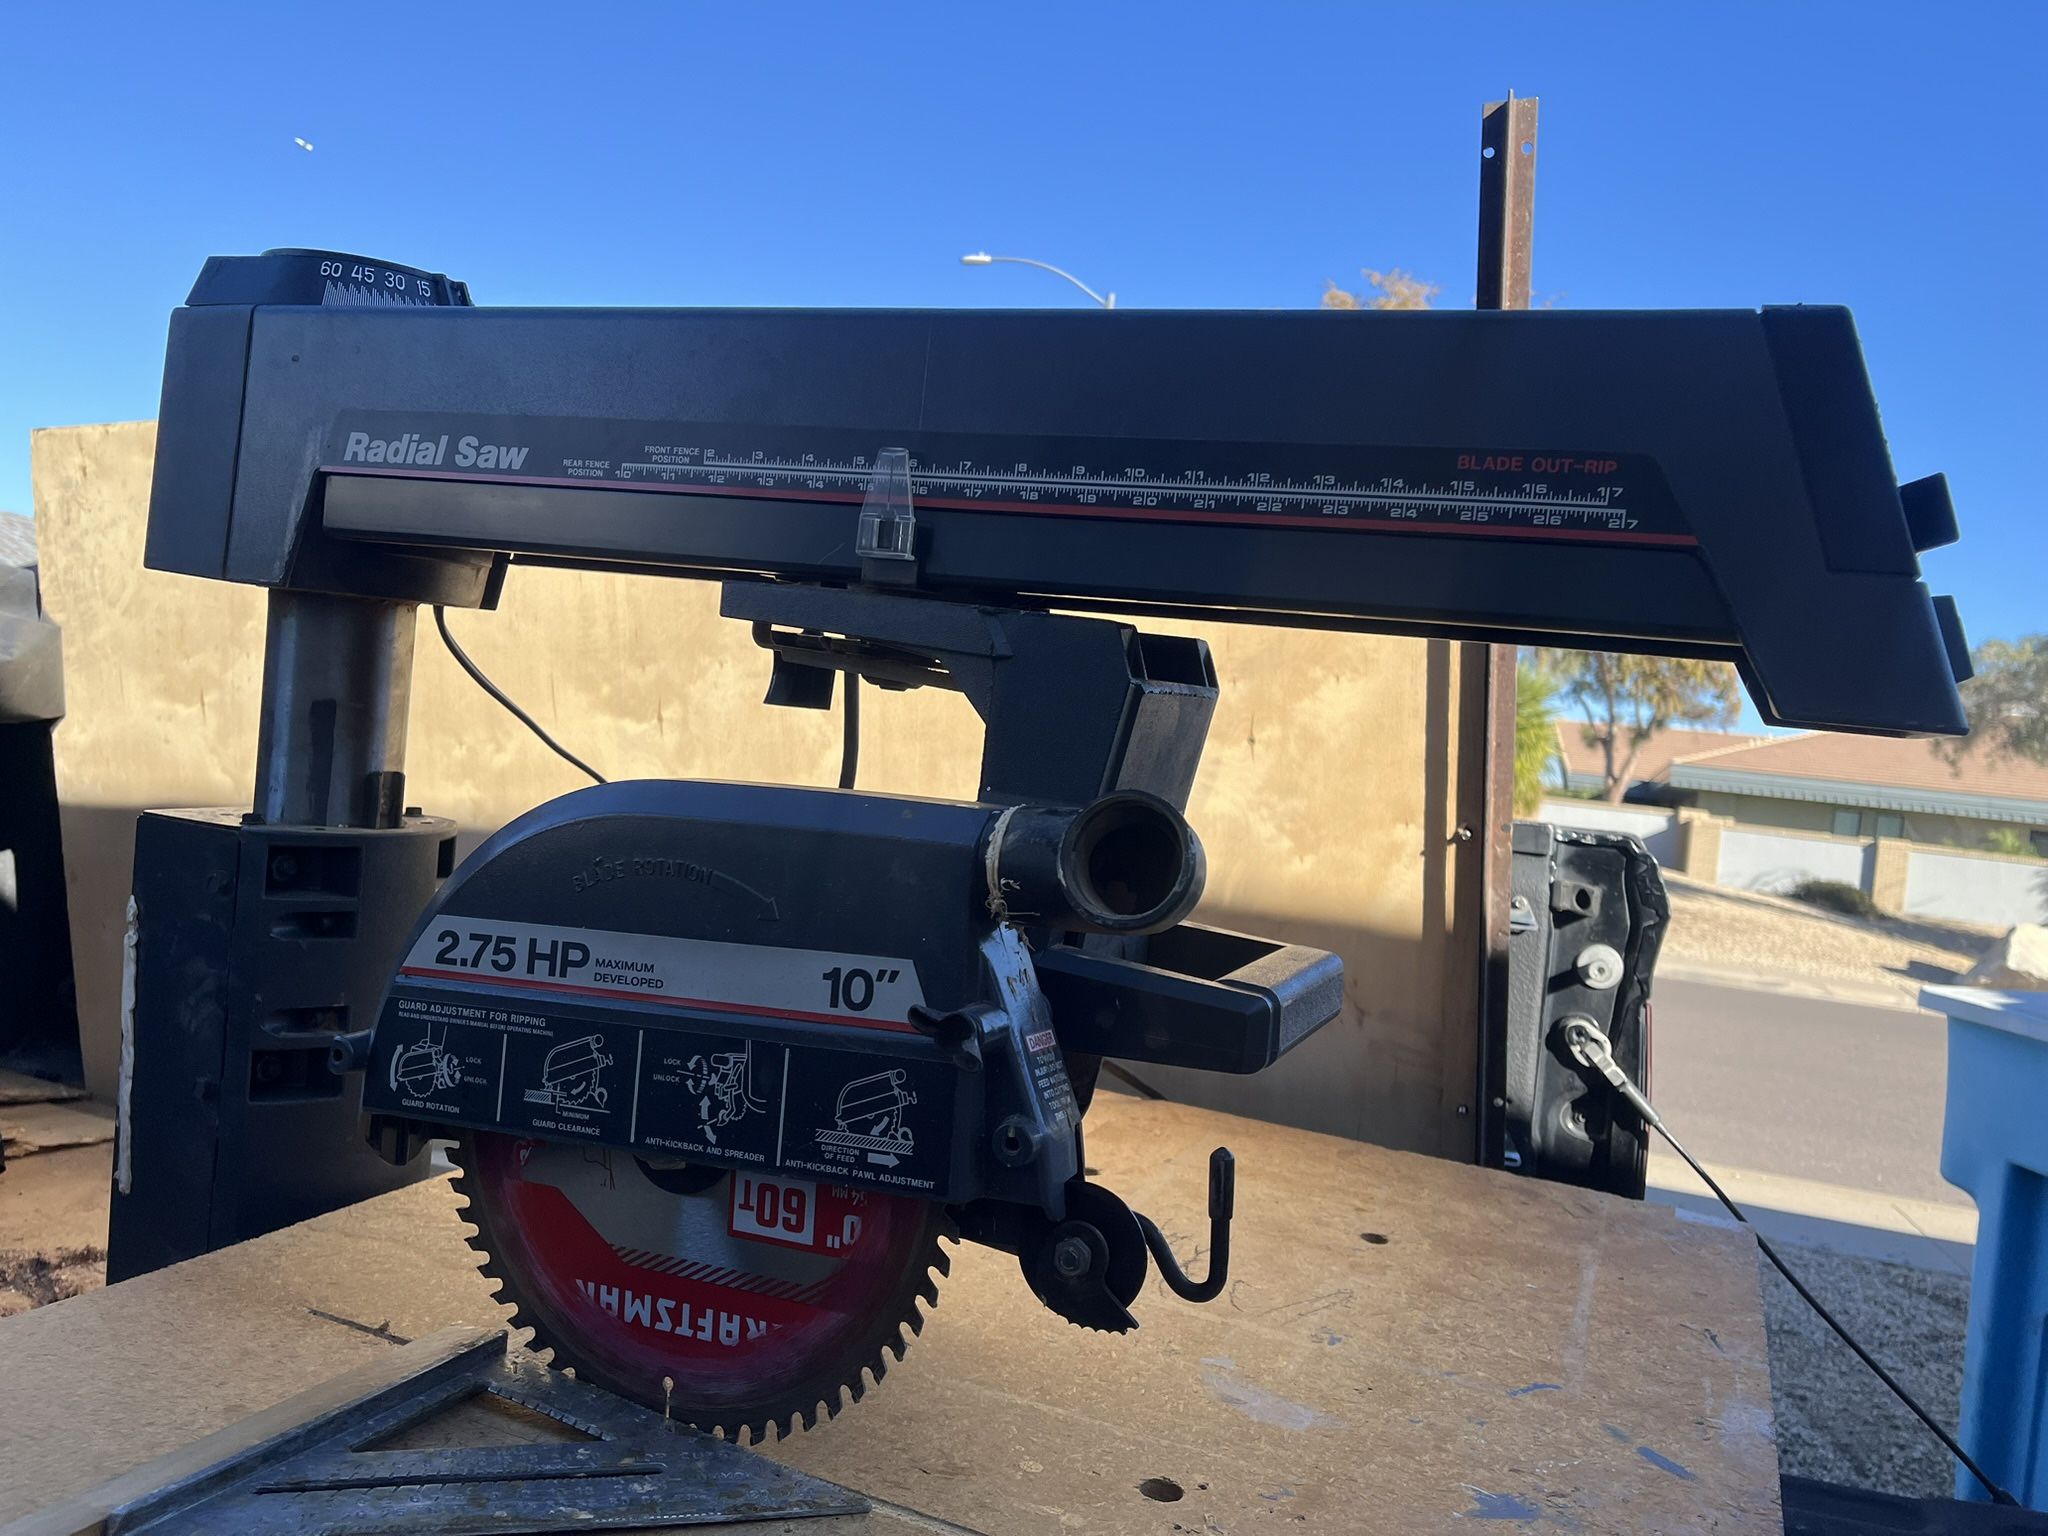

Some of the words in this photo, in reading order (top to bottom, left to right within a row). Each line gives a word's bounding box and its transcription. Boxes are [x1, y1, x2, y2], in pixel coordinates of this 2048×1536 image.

[320, 261, 343, 277] 60
[351, 265, 375, 283] 45
[385, 272, 405, 290] 30
[417, 280, 431, 297] 15
[344, 432, 449, 465] Radial
[455, 435, 529, 470] Saw
[645, 446, 671, 455] FRONT
[673, 447, 700, 456] FENCE
[652, 455, 690, 463] POSITION
[563, 459, 583, 468] REAR
[584, 460, 610, 469] FENCE
[568, 468, 603, 477] POSITION
[1457, 455, 1524, 471] BLADE
[1531, 457, 1618, 474] OUT-RIP
[707, 449, 715, 457] 2
[756, 451, 763, 460] 3
[805, 454, 814, 462] 4
[856, 456, 865, 465] 5
[909, 459, 917, 467] 6
[963, 461, 972, 470] 7
[1018, 463, 1027, 472] 8
[1076, 466, 1085, 474] 9
[1124, 467, 1145, 477] 10
[1185, 470, 1204, 479] 11
[1247, 472, 1270, 482] 12
[1313, 474, 1336, 485] 13
[1380, 477, 1404, 488] 14
[1450, 480, 1475, 491] 15
[1522, 483, 1547, 494] 16
[1597, 486, 1624, 497] 17
[615, 470, 631, 479] 10
[661, 472, 675, 481] 11
[707, 474, 725, 483] 12
[756, 477, 774, 486] 13
[807, 480, 824, 489] 14
[964, 488, 982, 498] 17
[1019, 491, 1039, 501] 18
[1077, 494, 1097, 503] 19
[1132, 496, 1157, 506] 20
[1193, 499, 1216, 509] 21
[1256, 502, 1282, 512] 22
[1322, 504, 1349, 515] 23
[1390, 508, 1418, 519] 24
[1460, 511, 1488, 522] 25
[1533, 515, 1562, 525] 26
[1608, 518, 1639, 529] 27
[571, 859, 625, 893] BLADE
[632, 857, 714, 885] ROTATION
[435, 930, 517, 972] 2.75
[526, 938, 591, 978] HP
[595, 958, 655, 973] MAXIMUM
[594, 972, 664, 989] DEVELOPED
[399, 1000, 427, 1011] GUARD
[430, 1004, 486, 1019] ADJUSTMENT
[489, 1011, 508, 1021] FOR
[510, 1014, 546, 1027] RIPPING
[1029, 1031, 1054, 1050] DANGER
[465, 1057, 482, 1065] LOCK
[664, 1058, 681, 1066] LOCK
[463, 1075, 488, 1085] UNLOCK
[653, 1074, 680, 1083] UNLOCK
[402, 1098, 425, 1109] GUARD
[426, 1102, 460, 1114] ROTATION
[562, 1111, 590, 1120] MINIMUM
[532, 1118, 556, 1129] GUARD
[558, 1123, 601, 1136] CLEARANCE
[645, 1136, 704, 1153] ANTI-KICKBACK
[706, 1145, 722, 1156] AND
[724, 1149, 765, 1162] SPREADER
[821, 1144, 860, 1156] DIRECTION
[824, 1152, 834, 1160] OF
[837, 1154, 856, 1163] FEED
[785, 1159, 849, 1175] ANTI-KICKBACK
[852, 1169, 876, 1181] PAWL
[878, 1173, 935, 1190] ADJUSTMENT
[739, 1178, 806, 1233] 60T
